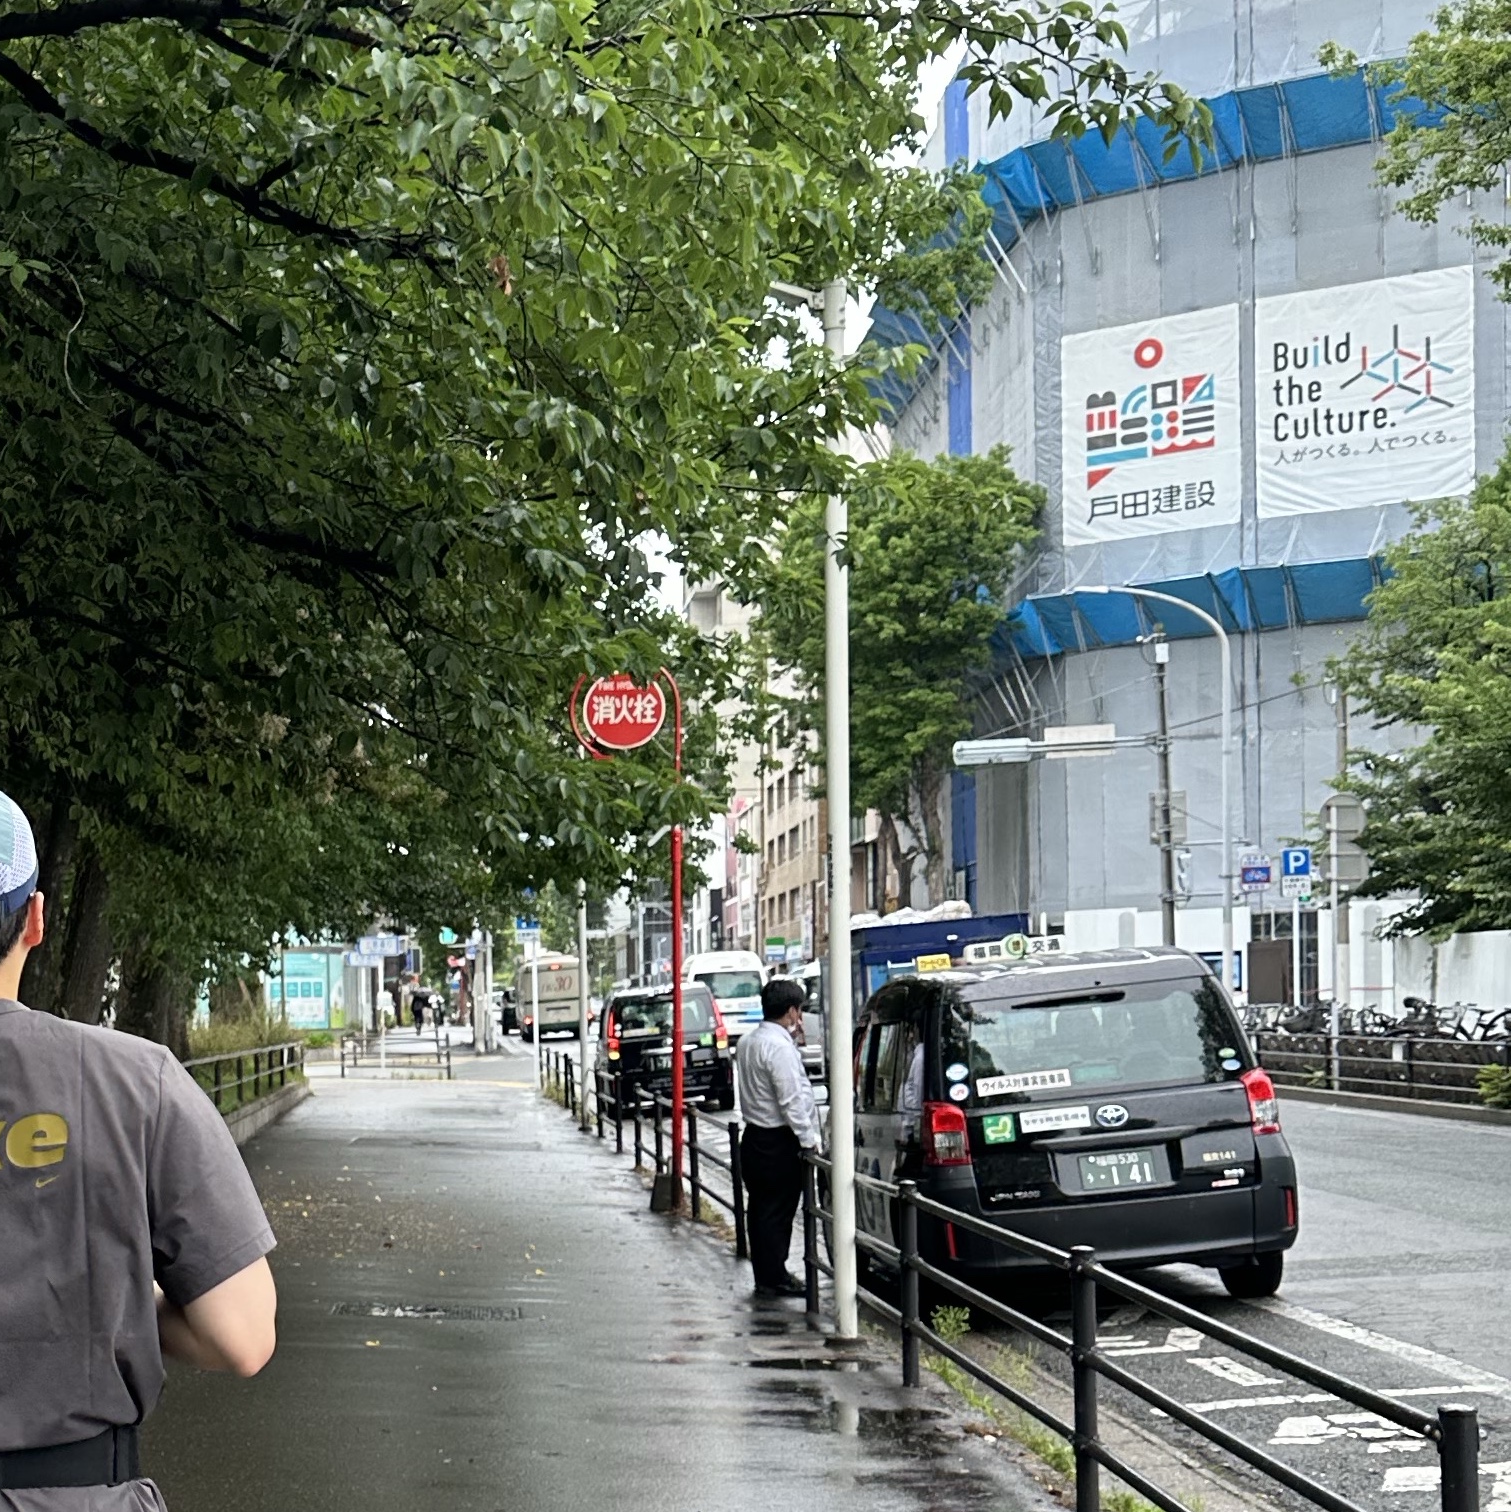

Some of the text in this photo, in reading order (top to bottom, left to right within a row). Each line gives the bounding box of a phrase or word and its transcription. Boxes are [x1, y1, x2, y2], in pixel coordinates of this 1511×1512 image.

[1273, 332, 1351, 373] Build
[1273, 375, 1323, 407] the
[1273, 406, 1397, 442] Culture.
[1086, 480, 1216, 525] 戸田建設
[591, 693, 658, 726] 消火栓
[1289, 851, 1306, 874] P
